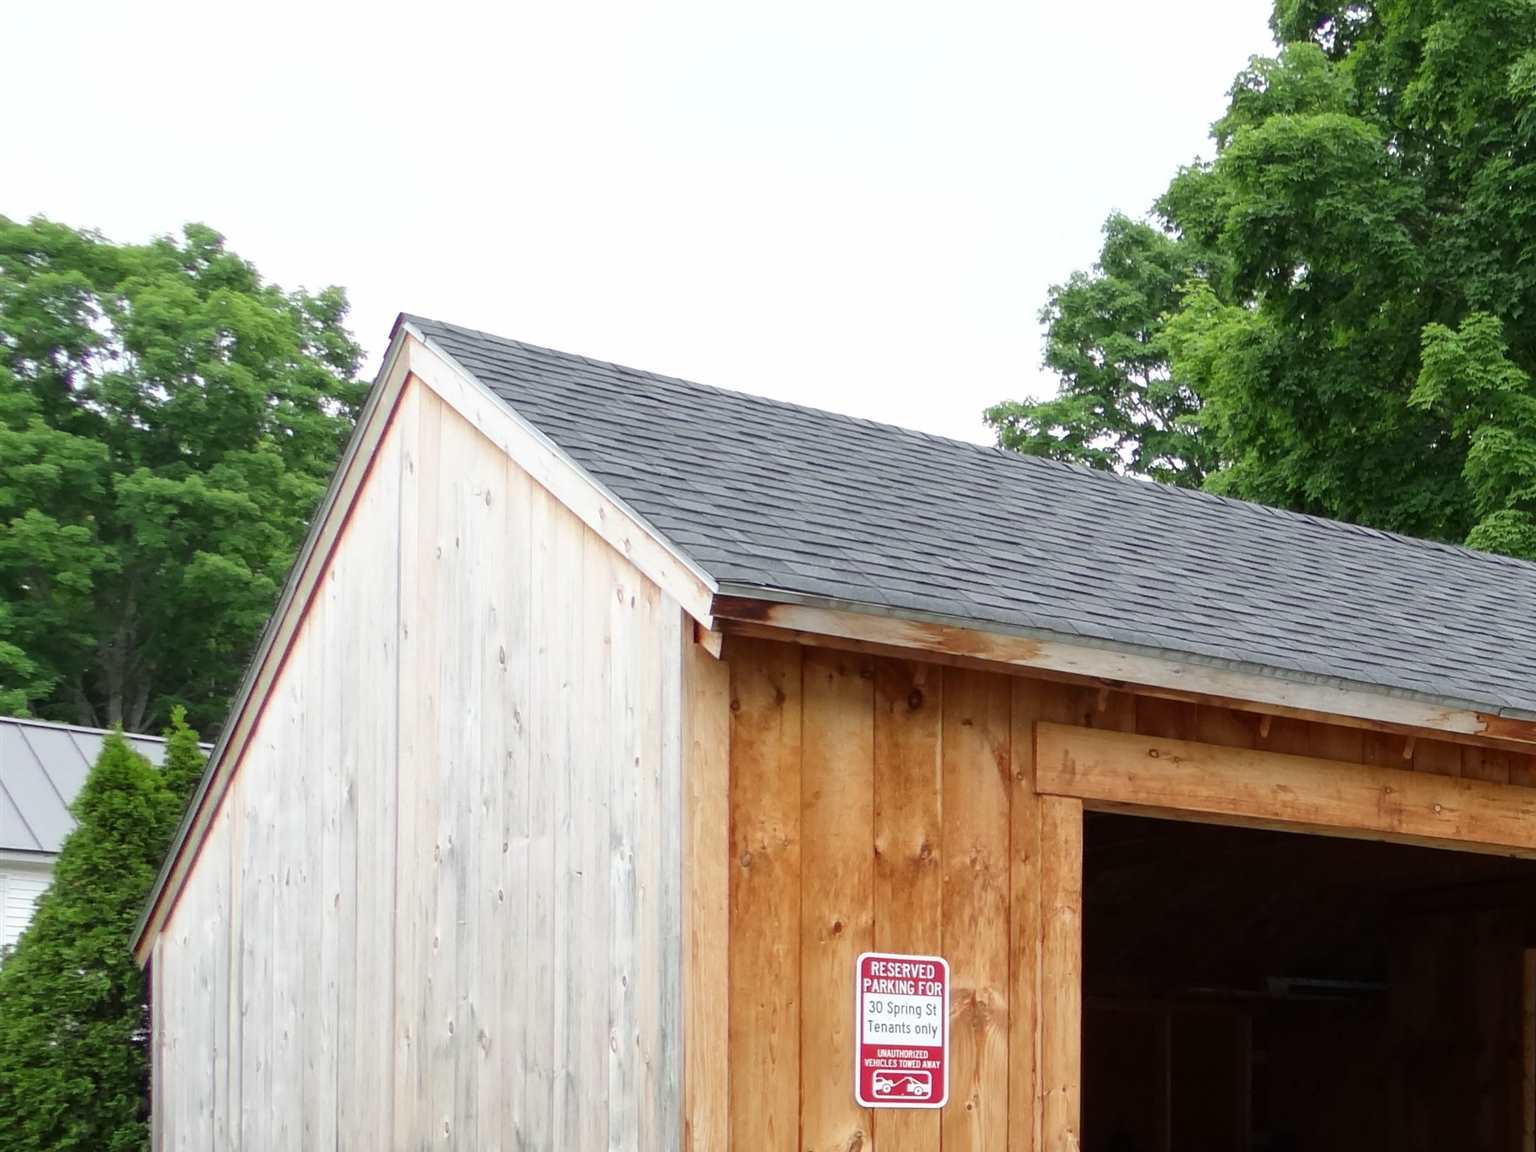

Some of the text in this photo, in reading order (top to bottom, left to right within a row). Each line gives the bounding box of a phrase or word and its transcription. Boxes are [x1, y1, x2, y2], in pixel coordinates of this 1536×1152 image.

[871, 961, 935, 979] RESERVED
[863, 978, 943, 996] PARKING FOR
[868, 1000, 937, 1019] 30 Spring St
[868, 1020, 938, 1039] Tenants only
[877, 1049, 929, 1059] UNAUTHORIZED
[864, 1058, 898, 1068] VEHICLES
[921, 1060, 941, 1069] AWAY
